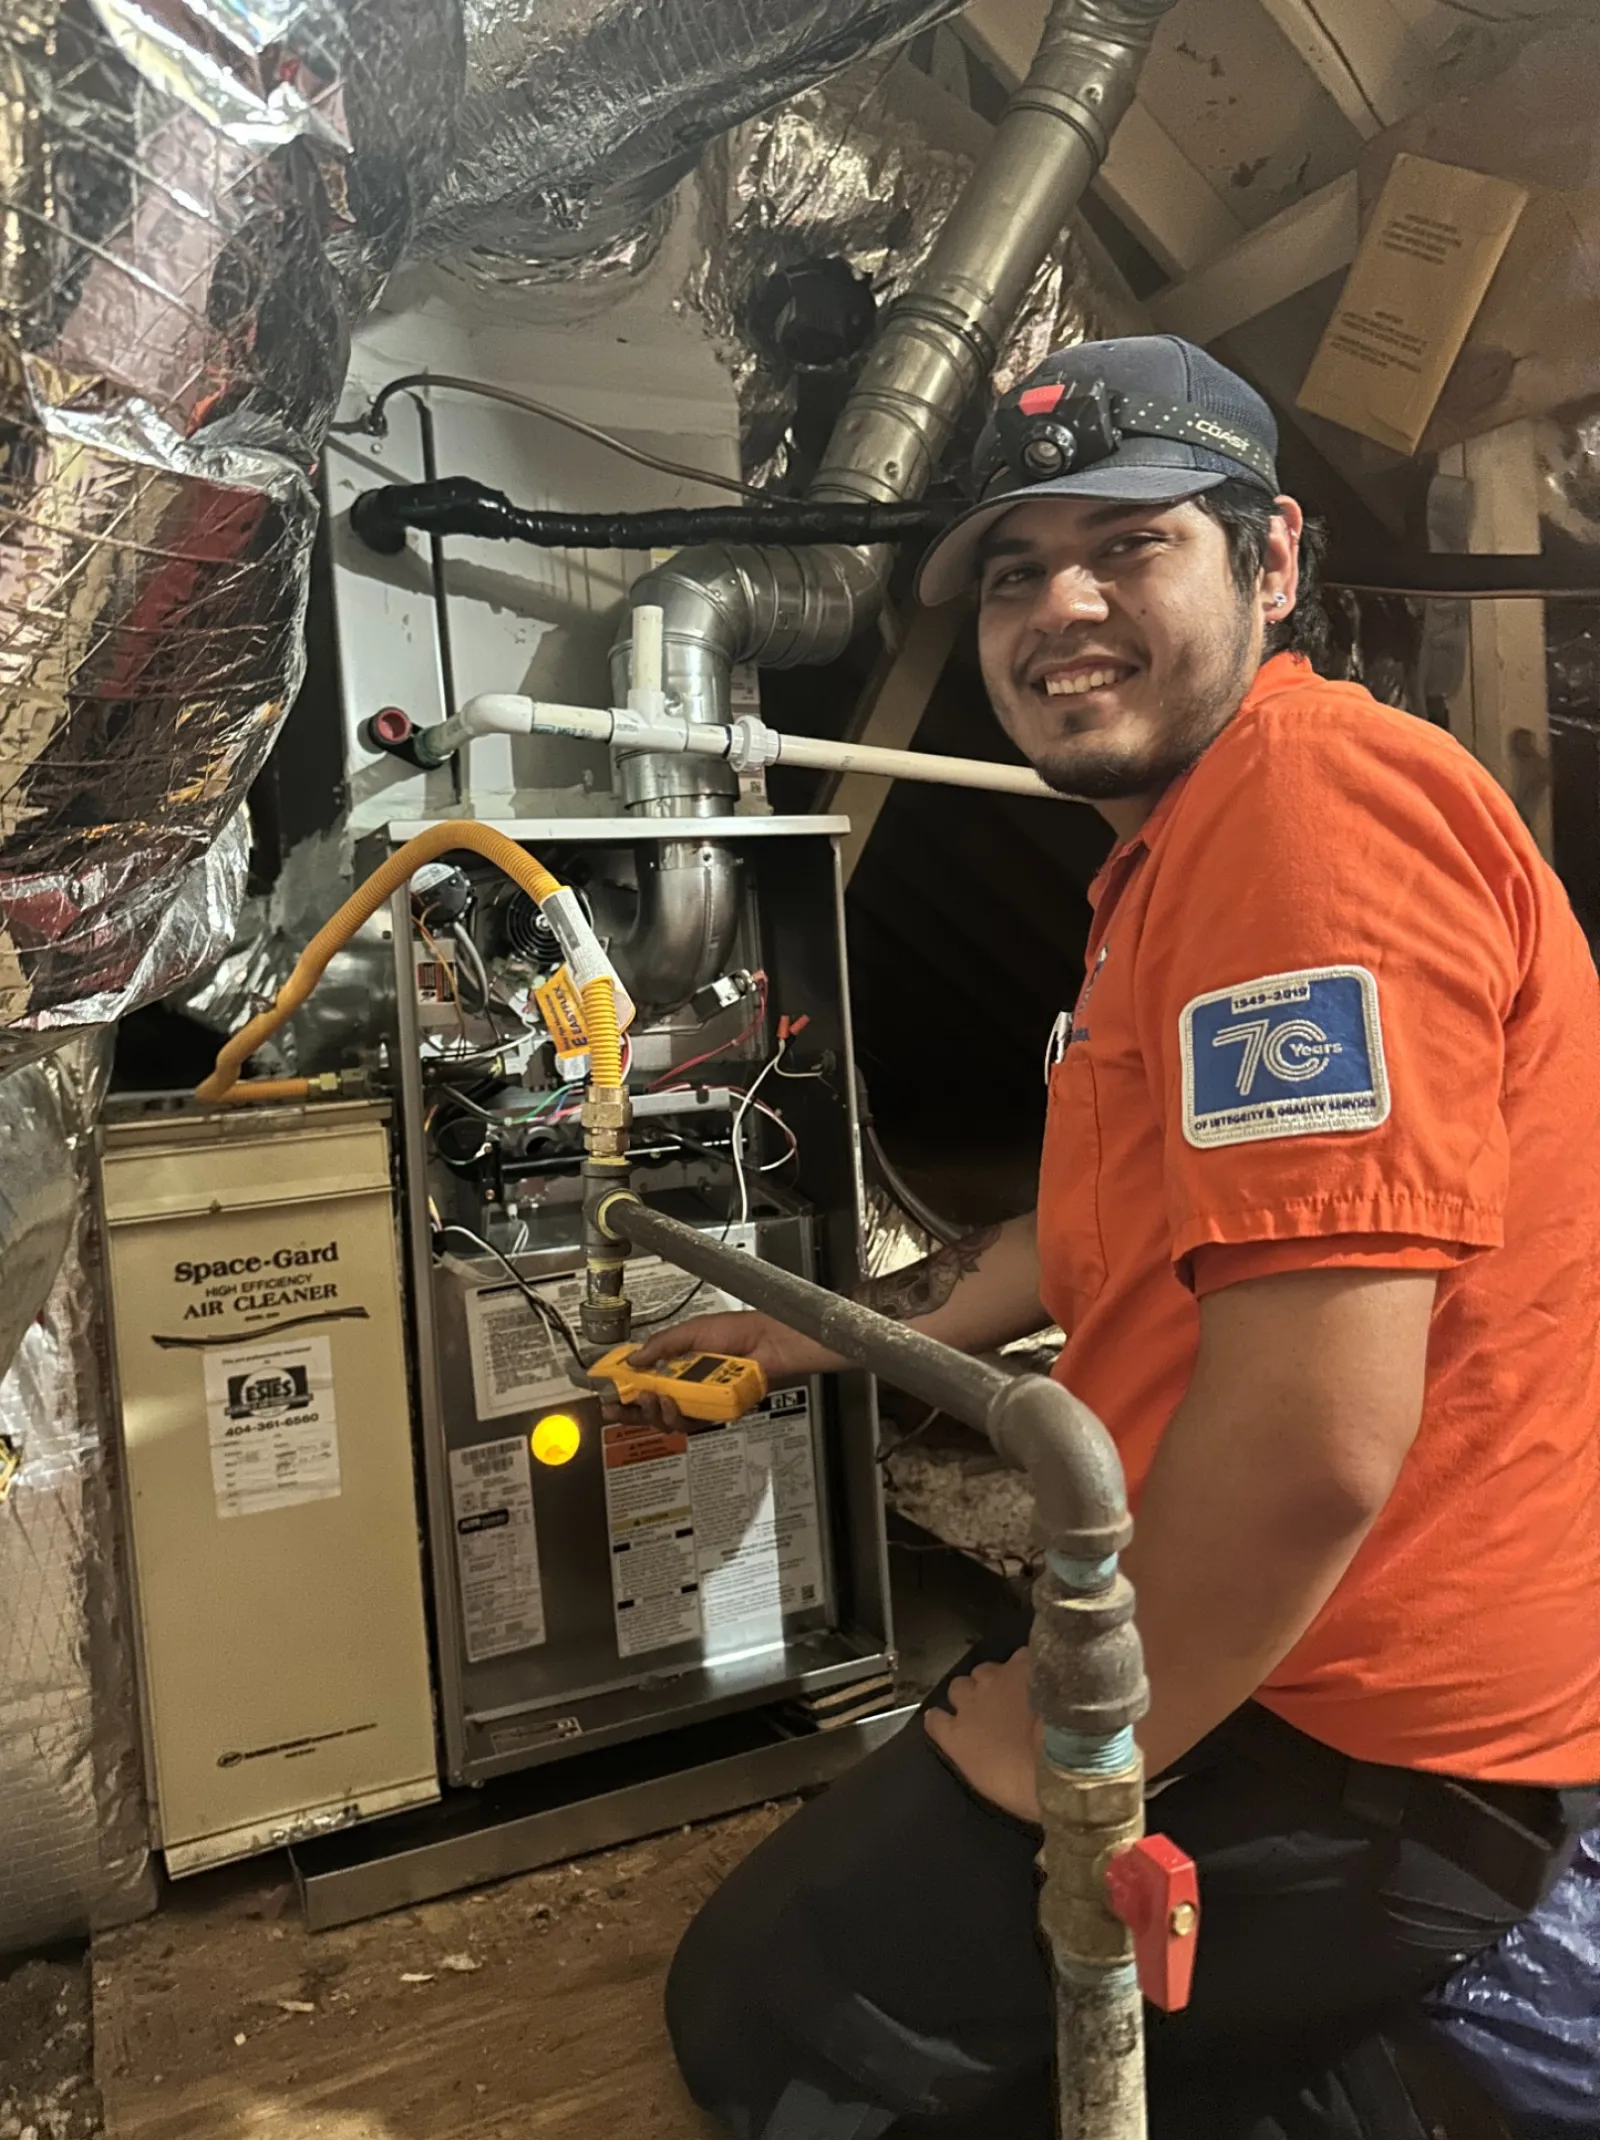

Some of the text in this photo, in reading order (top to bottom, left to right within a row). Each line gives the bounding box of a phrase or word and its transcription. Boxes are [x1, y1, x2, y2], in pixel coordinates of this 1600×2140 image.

[1195, 419, 1250, 451] COAST
[553, 985, 583, 1035] EASYFLEX
[1289, 1042, 1343, 1057] Years
[1194, 1119, 1208, 1130] OF
[174, 1240, 340, 1285] Space-Gard
[205, 1273, 314, 1298] HIGH EFFICIENCY
[183, 1300, 225, 1321] AIR
[233, 1283, 339, 1313] CLEANER
[246, 1376, 293, 1402] ESTES
